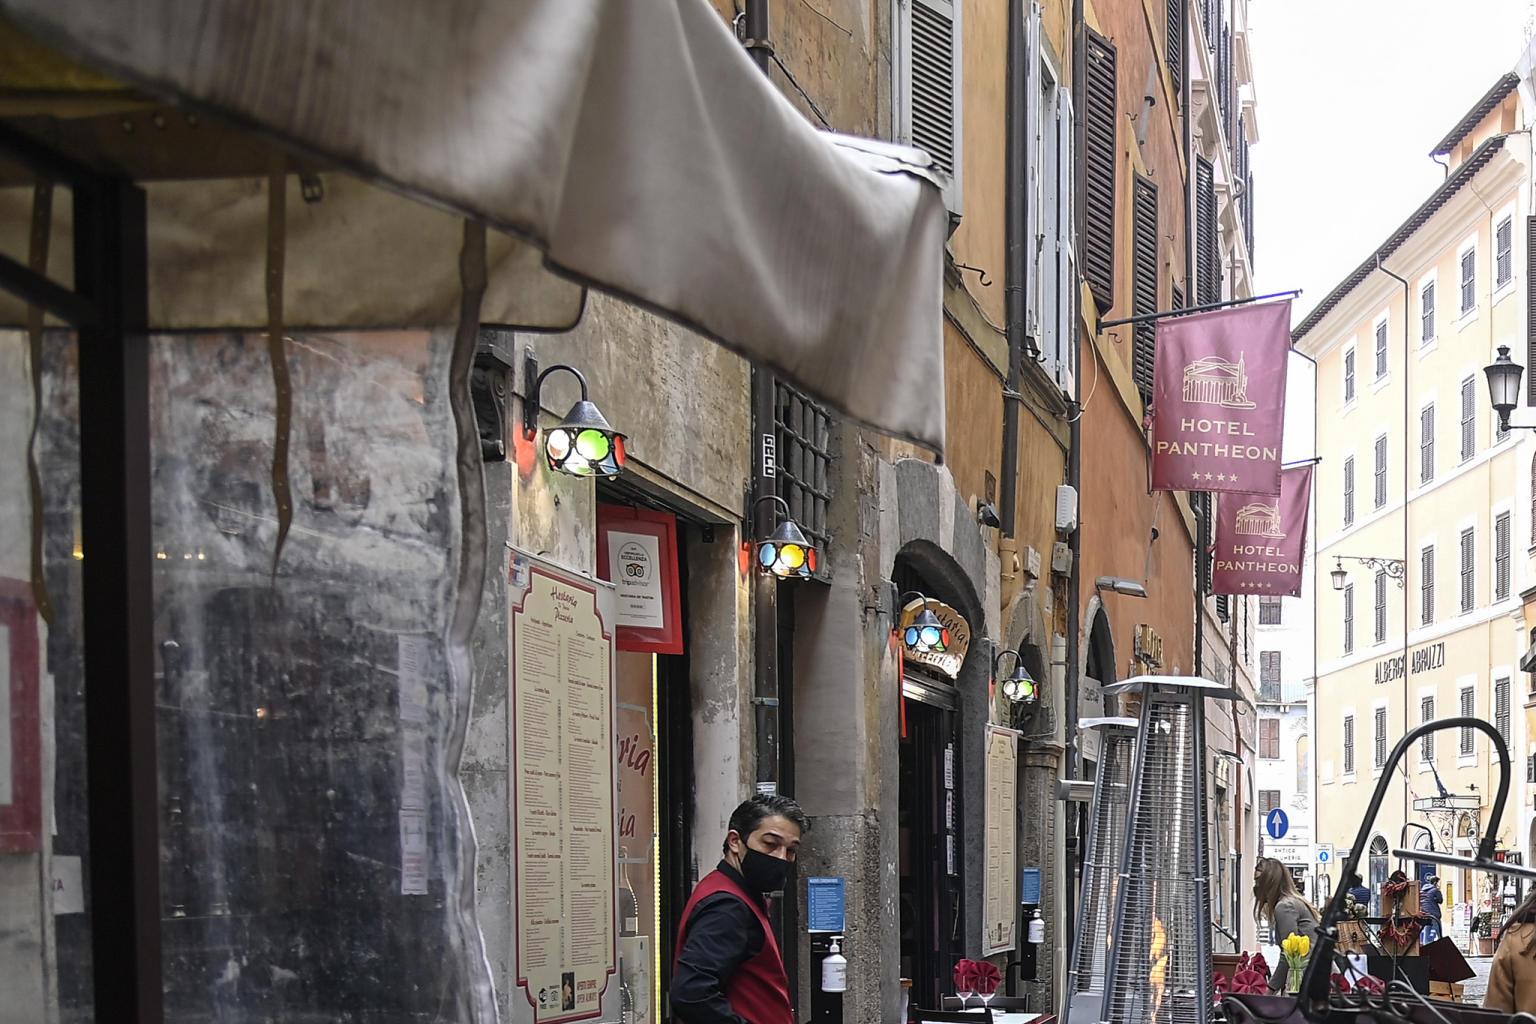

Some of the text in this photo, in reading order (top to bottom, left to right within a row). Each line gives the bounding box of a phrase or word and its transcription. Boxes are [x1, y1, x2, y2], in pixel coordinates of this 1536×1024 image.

[1181, 418, 1255, 436] HOTEL
[1157, 441, 1277, 461] PANTHEON
[1233, 545, 1285, 557] HOTEL
[1216, 561, 1300, 574] PANTHEON
[1411, 642, 1445, 674] ABRUZZI
